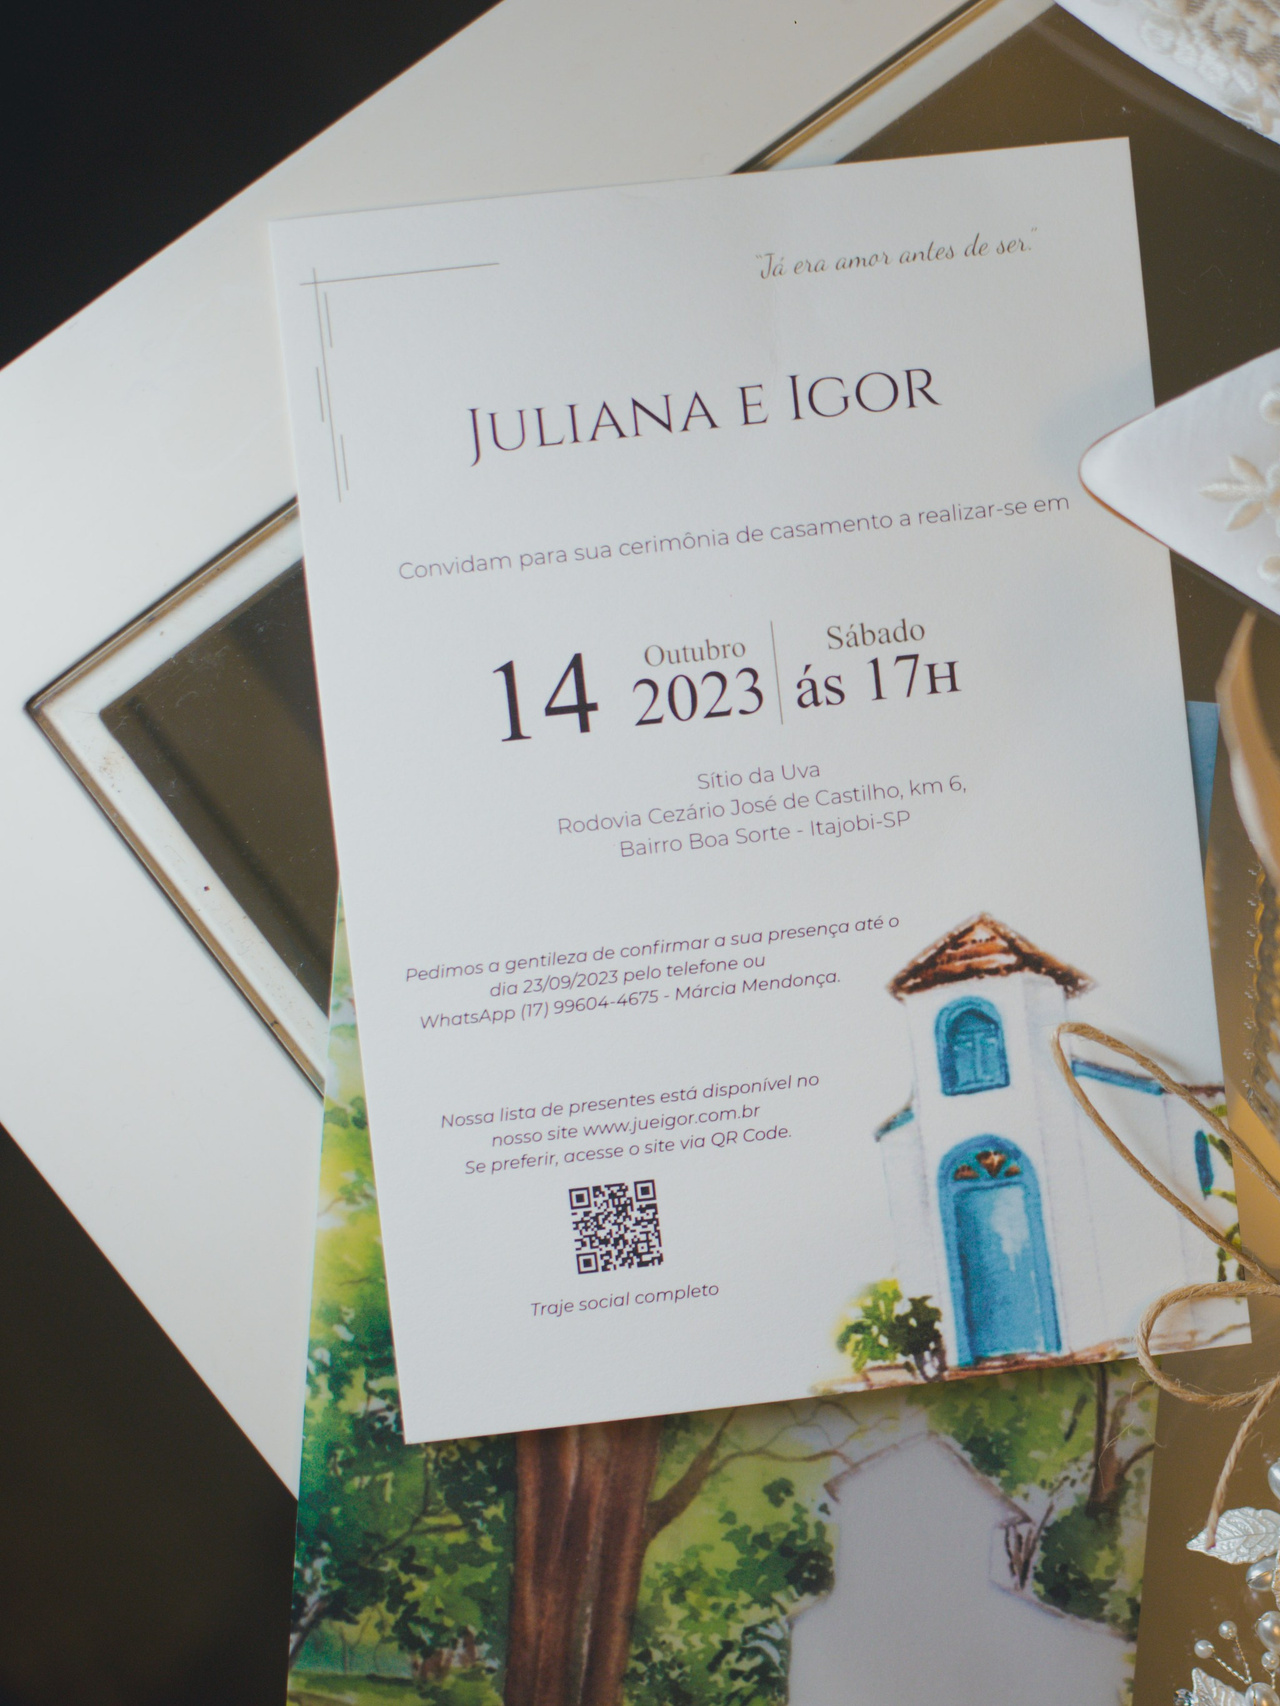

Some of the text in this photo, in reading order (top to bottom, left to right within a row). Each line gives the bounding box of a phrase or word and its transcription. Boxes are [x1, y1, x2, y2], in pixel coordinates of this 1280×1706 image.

[792, 258, 826, 275] era
[834, 250, 890, 272] amor
[897, 239, 956, 266] antes
[963, 231, 989, 259] de
[467, 367, 941, 468] JULIANA E IGOR
[397, 496, 1071, 581] Convidam para sua cerimônia de casamento a realizar-se em
[642, 637, 747, 668] Outubro
[825, 617, 927, 651] Sábado
[491, 652, 600, 743] 14
[632, 665, 765, 727] 2023
[795, 663, 847, 710] ás
[696, 762, 821, 791] Sítio da Uva
[557, 773, 967, 836] Rodovia Cezário José de Castilho, km 6,
[619, 838, 683, 859] Bairro
[688, 831, 730, 851] Boa
[734, 825, 792, 845] Sorte
[809, 809, 912, 839] Itajobi-SP
[405, 914, 900, 983] Pedimos a gentileza de confirmar a sua presença até o
[420, 1007, 517, 1030] WhatsApp
[520, 1001, 550, 1022] (17)
[552, 988, 660, 1016] 99604-4675
[674, 982, 737, 1002] Márcia
[741, 971, 841, 994] Mendonça.
[488, 955, 766, 998] dia 23/09/2023 pelo telefone ou
[440, 1073, 820, 1129] Nossa lista de presentes está disponível no
[491, 1103, 762, 1148] nosso site www.jueigor.com.br
[464, 1124, 793, 1176] Se preferir, acesse o site via QR Code.
[530, 1283, 720, 1319] Traje social completo
